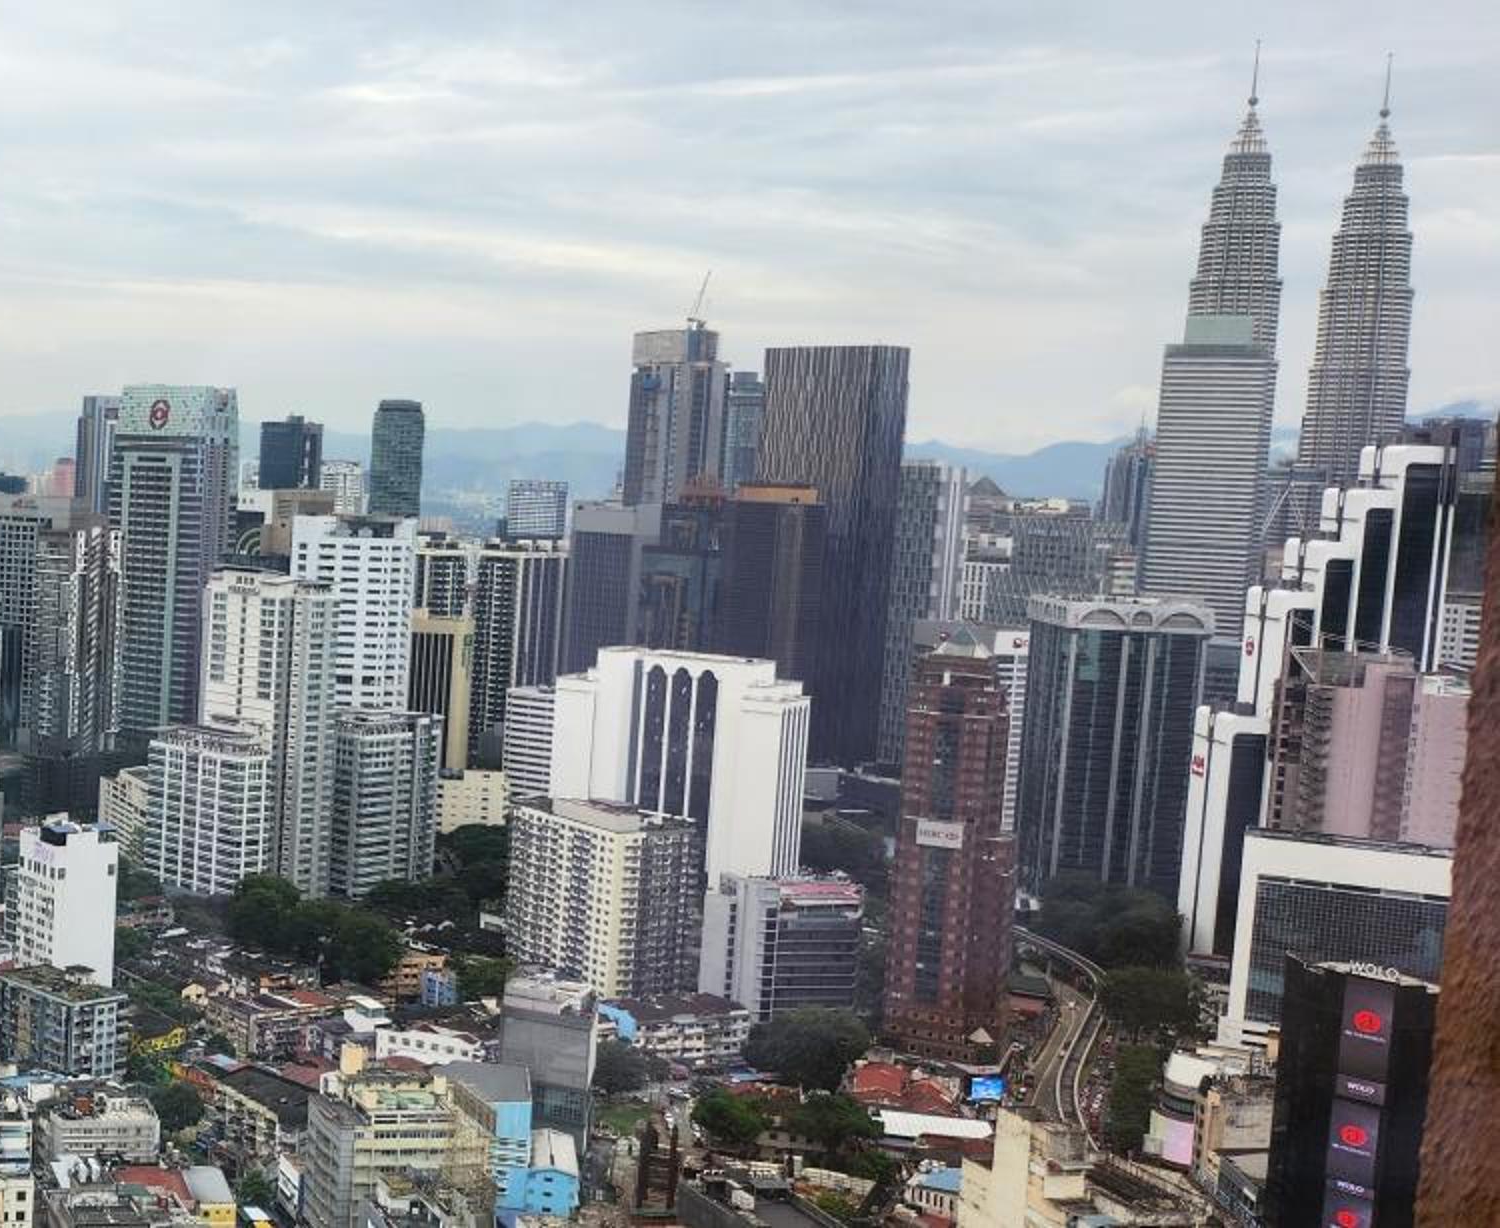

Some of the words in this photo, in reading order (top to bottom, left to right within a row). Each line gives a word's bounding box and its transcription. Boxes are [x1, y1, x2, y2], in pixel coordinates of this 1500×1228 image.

[1350, 960, 1399, 980] WOLO
[1347, 1081, 1376, 1095] WOLO
[1337, 1180, 1365, 1193] WOLO
